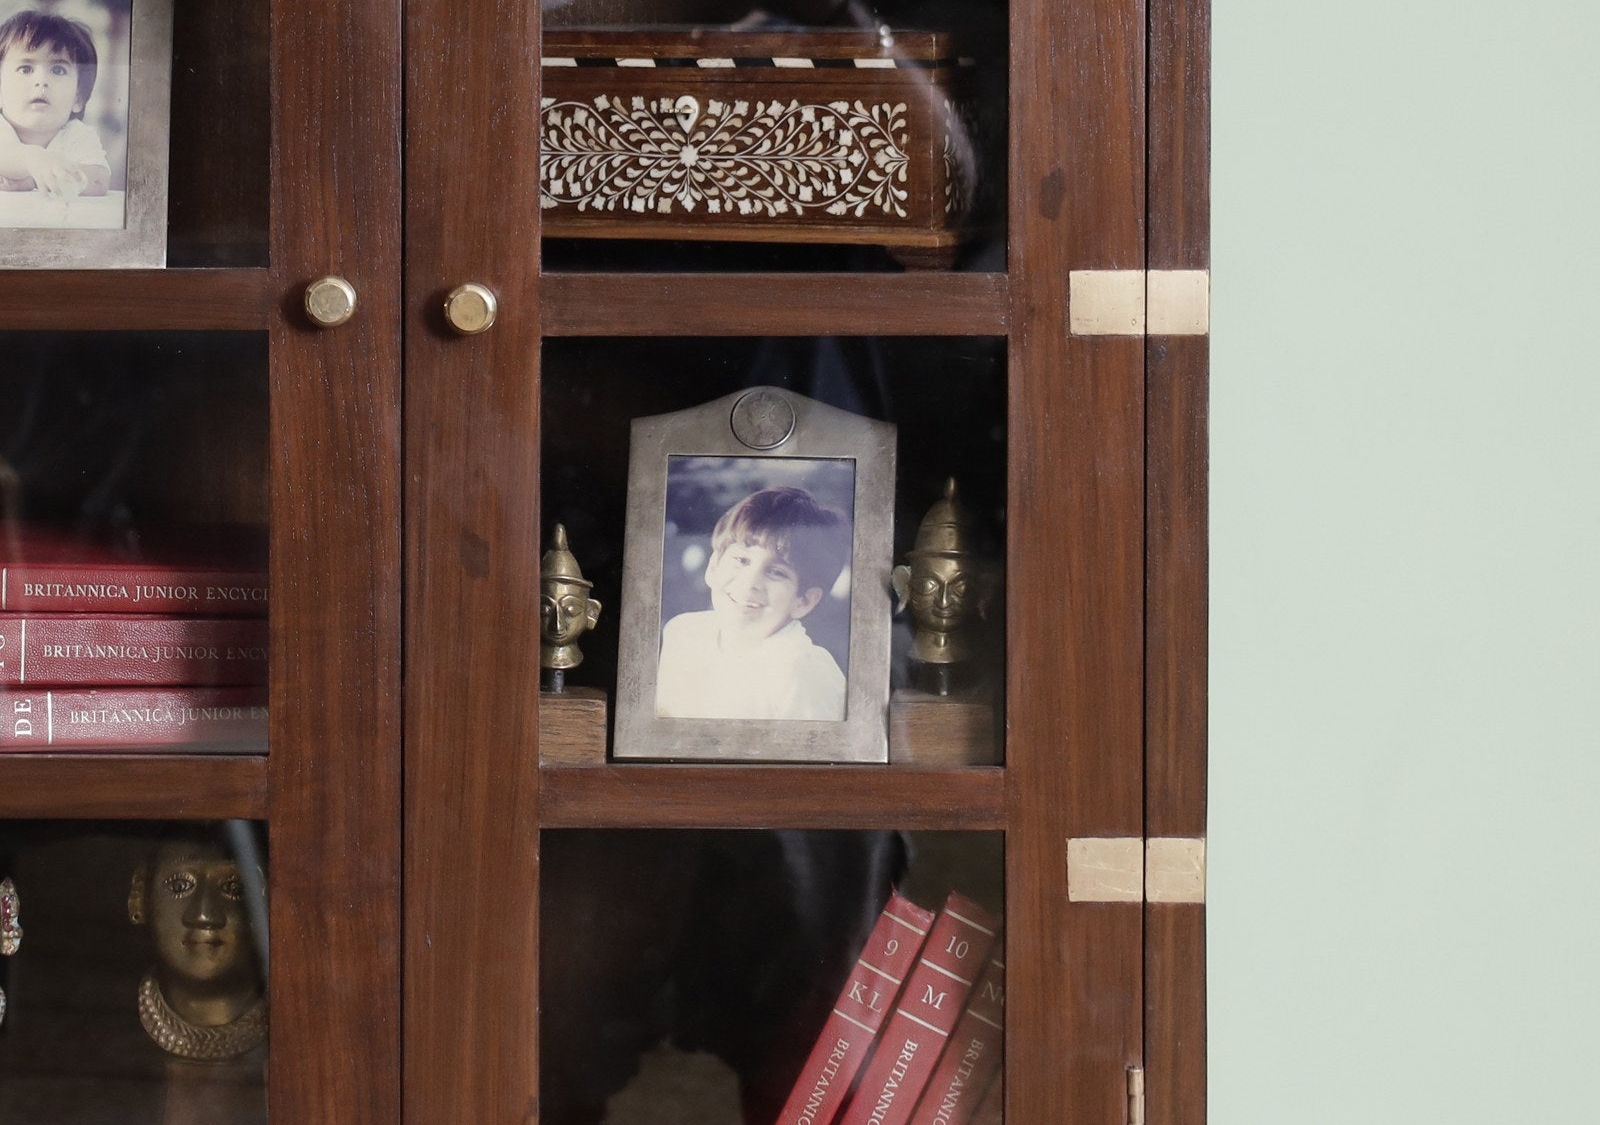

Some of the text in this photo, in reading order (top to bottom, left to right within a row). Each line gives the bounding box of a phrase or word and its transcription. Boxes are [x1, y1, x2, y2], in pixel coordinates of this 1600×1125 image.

[23, 582, 129, 599] BRITANNICA
[133, 583, 199, 602] JUNIOR
[43, 643, 149, 660] BRITANNICA
[153, 646, 219, 664] JUNIOR
[70, 708, 173, 724] BRITANNICA
[178, 707, 243, 725] JUNIOR
[883, 939, 899, 956] 9
[945, 936, 969, 959] 10
[921, 985, 948, 1011] M
